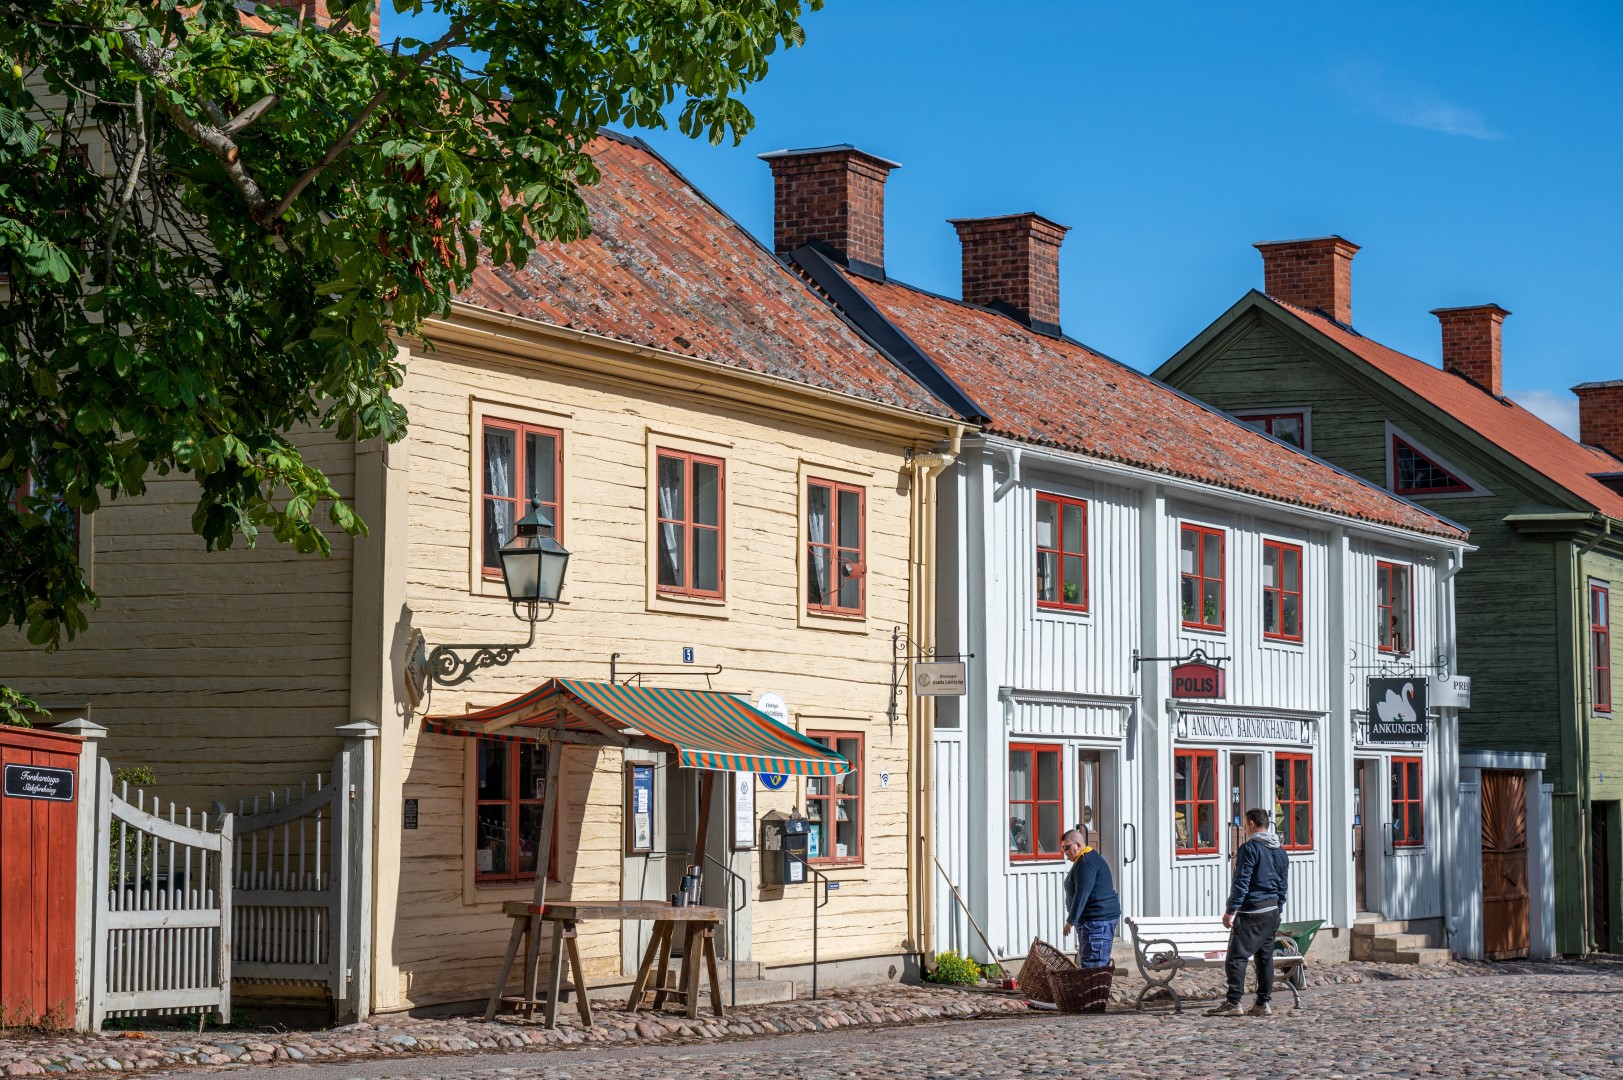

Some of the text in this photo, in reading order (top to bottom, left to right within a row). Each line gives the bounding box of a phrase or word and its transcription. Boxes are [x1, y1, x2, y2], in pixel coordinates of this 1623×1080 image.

[1175, 677, 1213, 692] POLIS
[1192, 716, 1298, 740] ANKUNGEN BARNBOKHANDEL
[1372, 723, 1423, 734] ANKUNGEN
